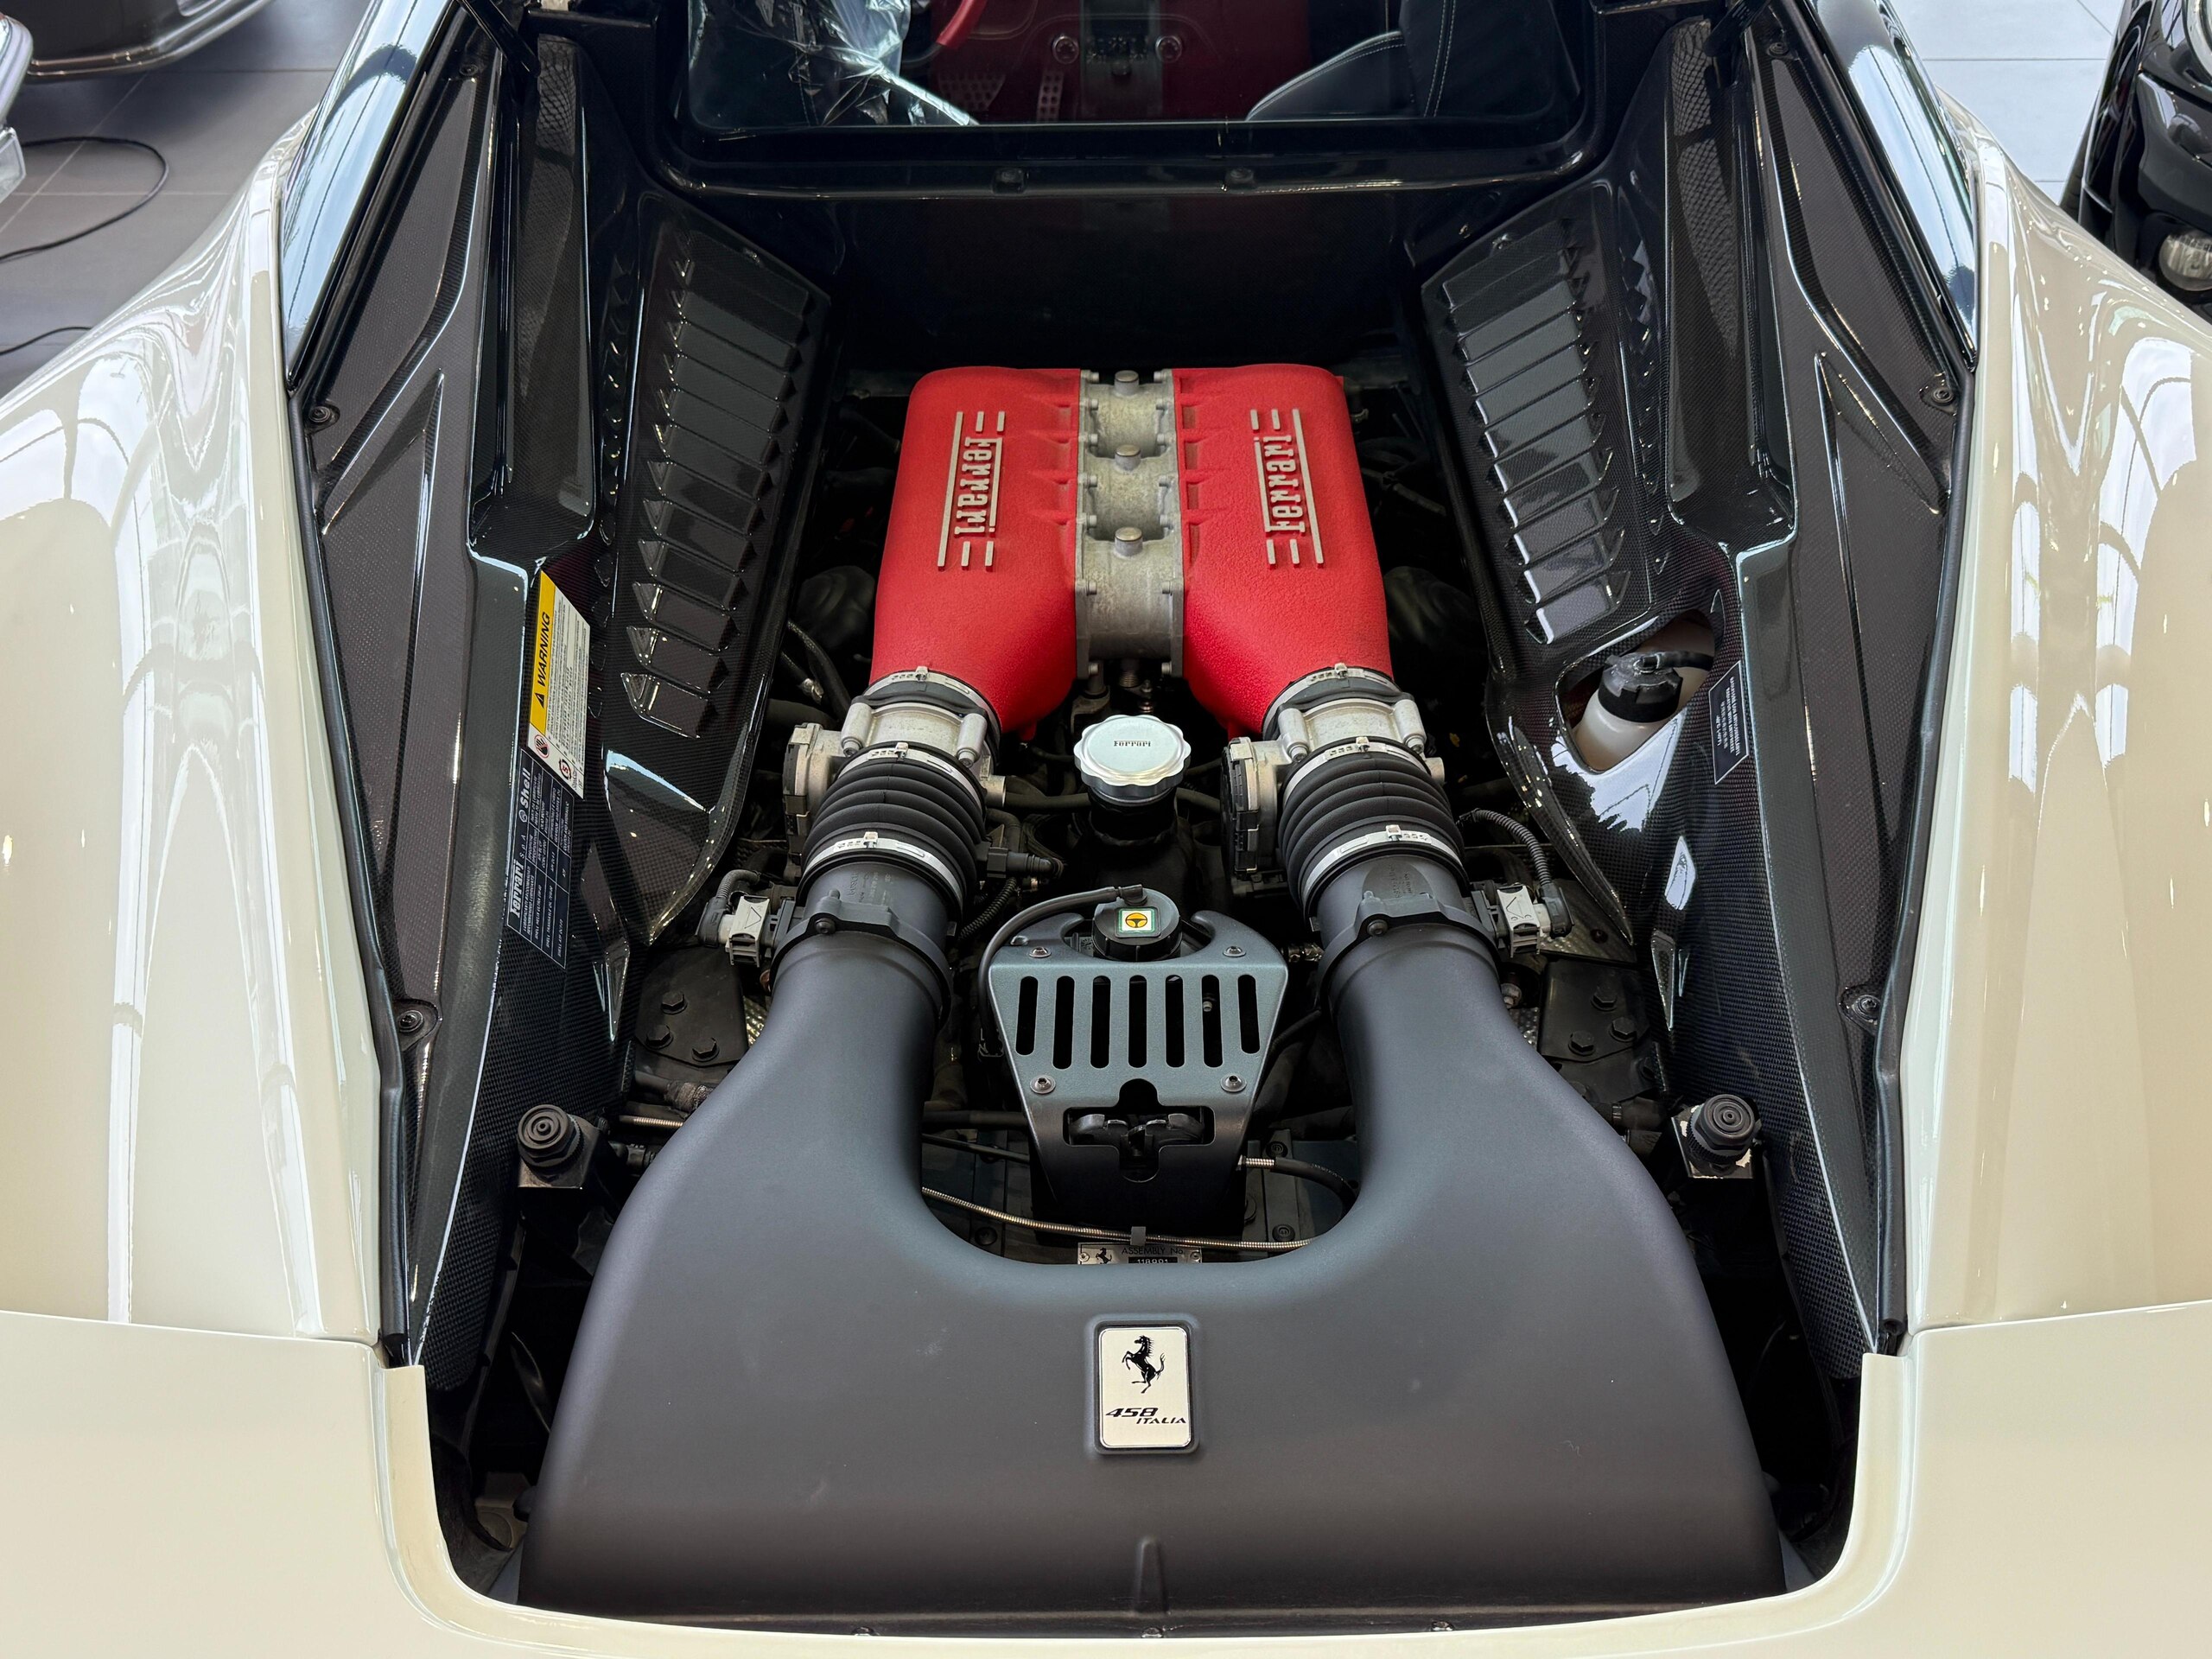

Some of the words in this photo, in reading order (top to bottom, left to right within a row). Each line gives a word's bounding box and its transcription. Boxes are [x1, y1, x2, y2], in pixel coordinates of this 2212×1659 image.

[954, 436, 1002, 536] Ferrari
[1254, 434, 1306, 535] Ferrari
[537, 612, 550, 687] WARNING
[510, 859, 524, 918] Ferrari
[519, 767, 531, 809] Shell
[1106, 1408, 1159, 1417] 458
